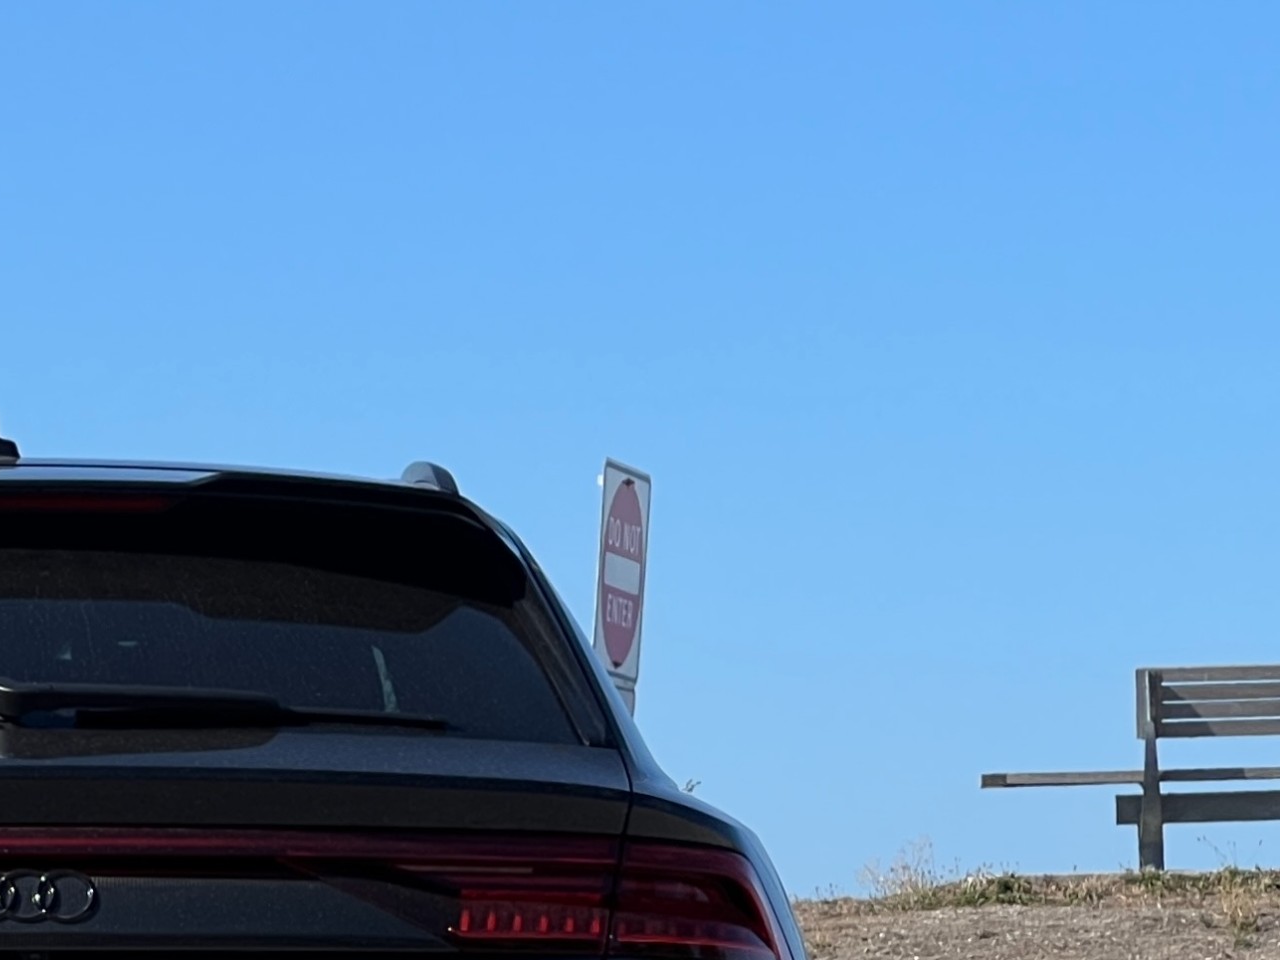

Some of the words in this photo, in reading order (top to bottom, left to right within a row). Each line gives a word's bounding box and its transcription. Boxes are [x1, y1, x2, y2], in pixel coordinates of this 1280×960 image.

[608, 516, 621, 547] DO
[623, 522, 641, 555] NOT
[606, 593, 633, 628] ENTER
